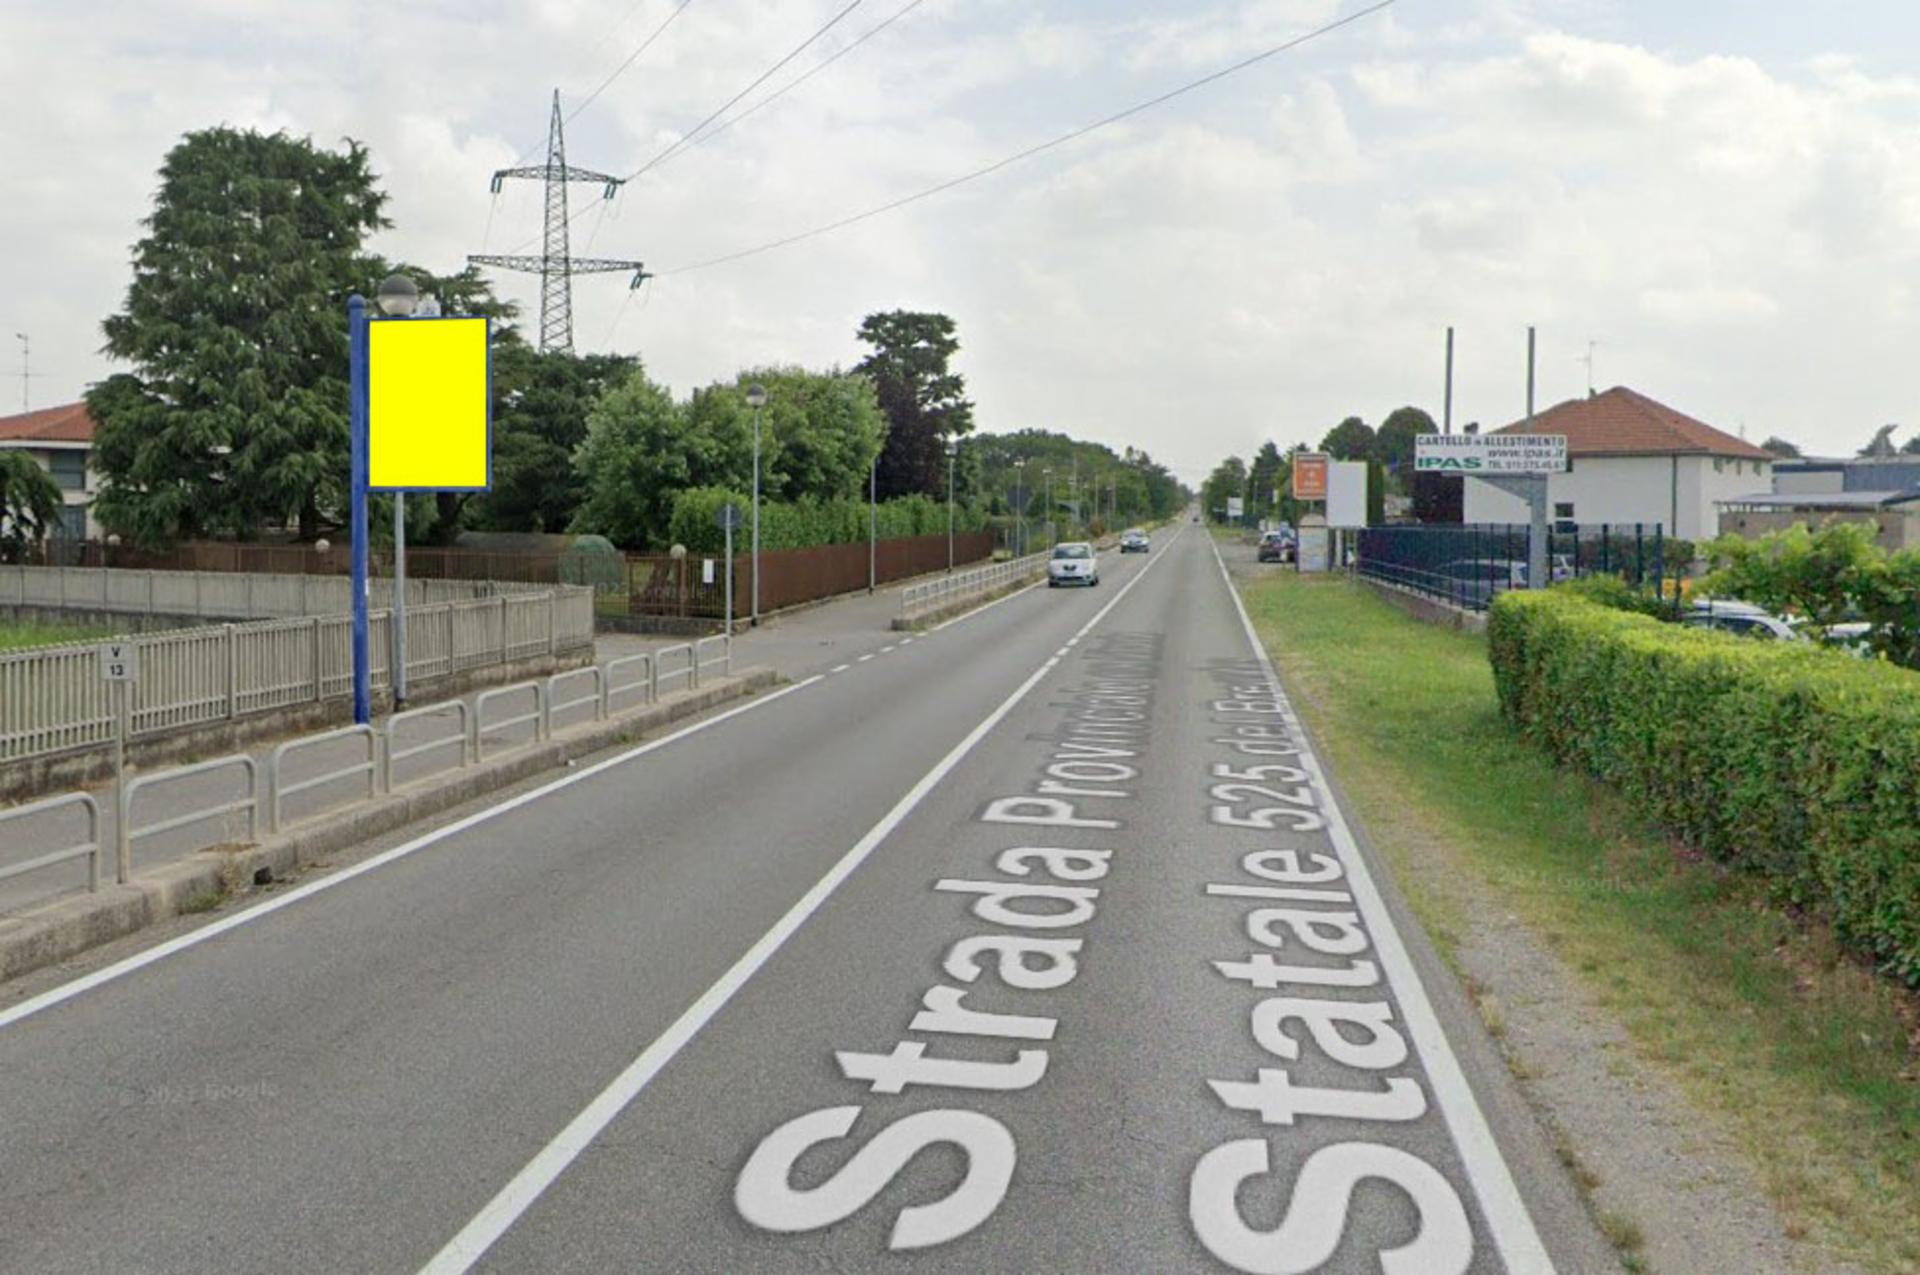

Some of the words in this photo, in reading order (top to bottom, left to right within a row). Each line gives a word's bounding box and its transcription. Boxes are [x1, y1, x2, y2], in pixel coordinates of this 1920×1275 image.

[1417, 436, 1473, 447] CARTELLO
[1484, 436, 1566, 447] ALLESTIMENTO
[1417, 456, 1483, 469] IPAS
[111, 646, 121, 658] V
[110, 664, 124, 676] 13
